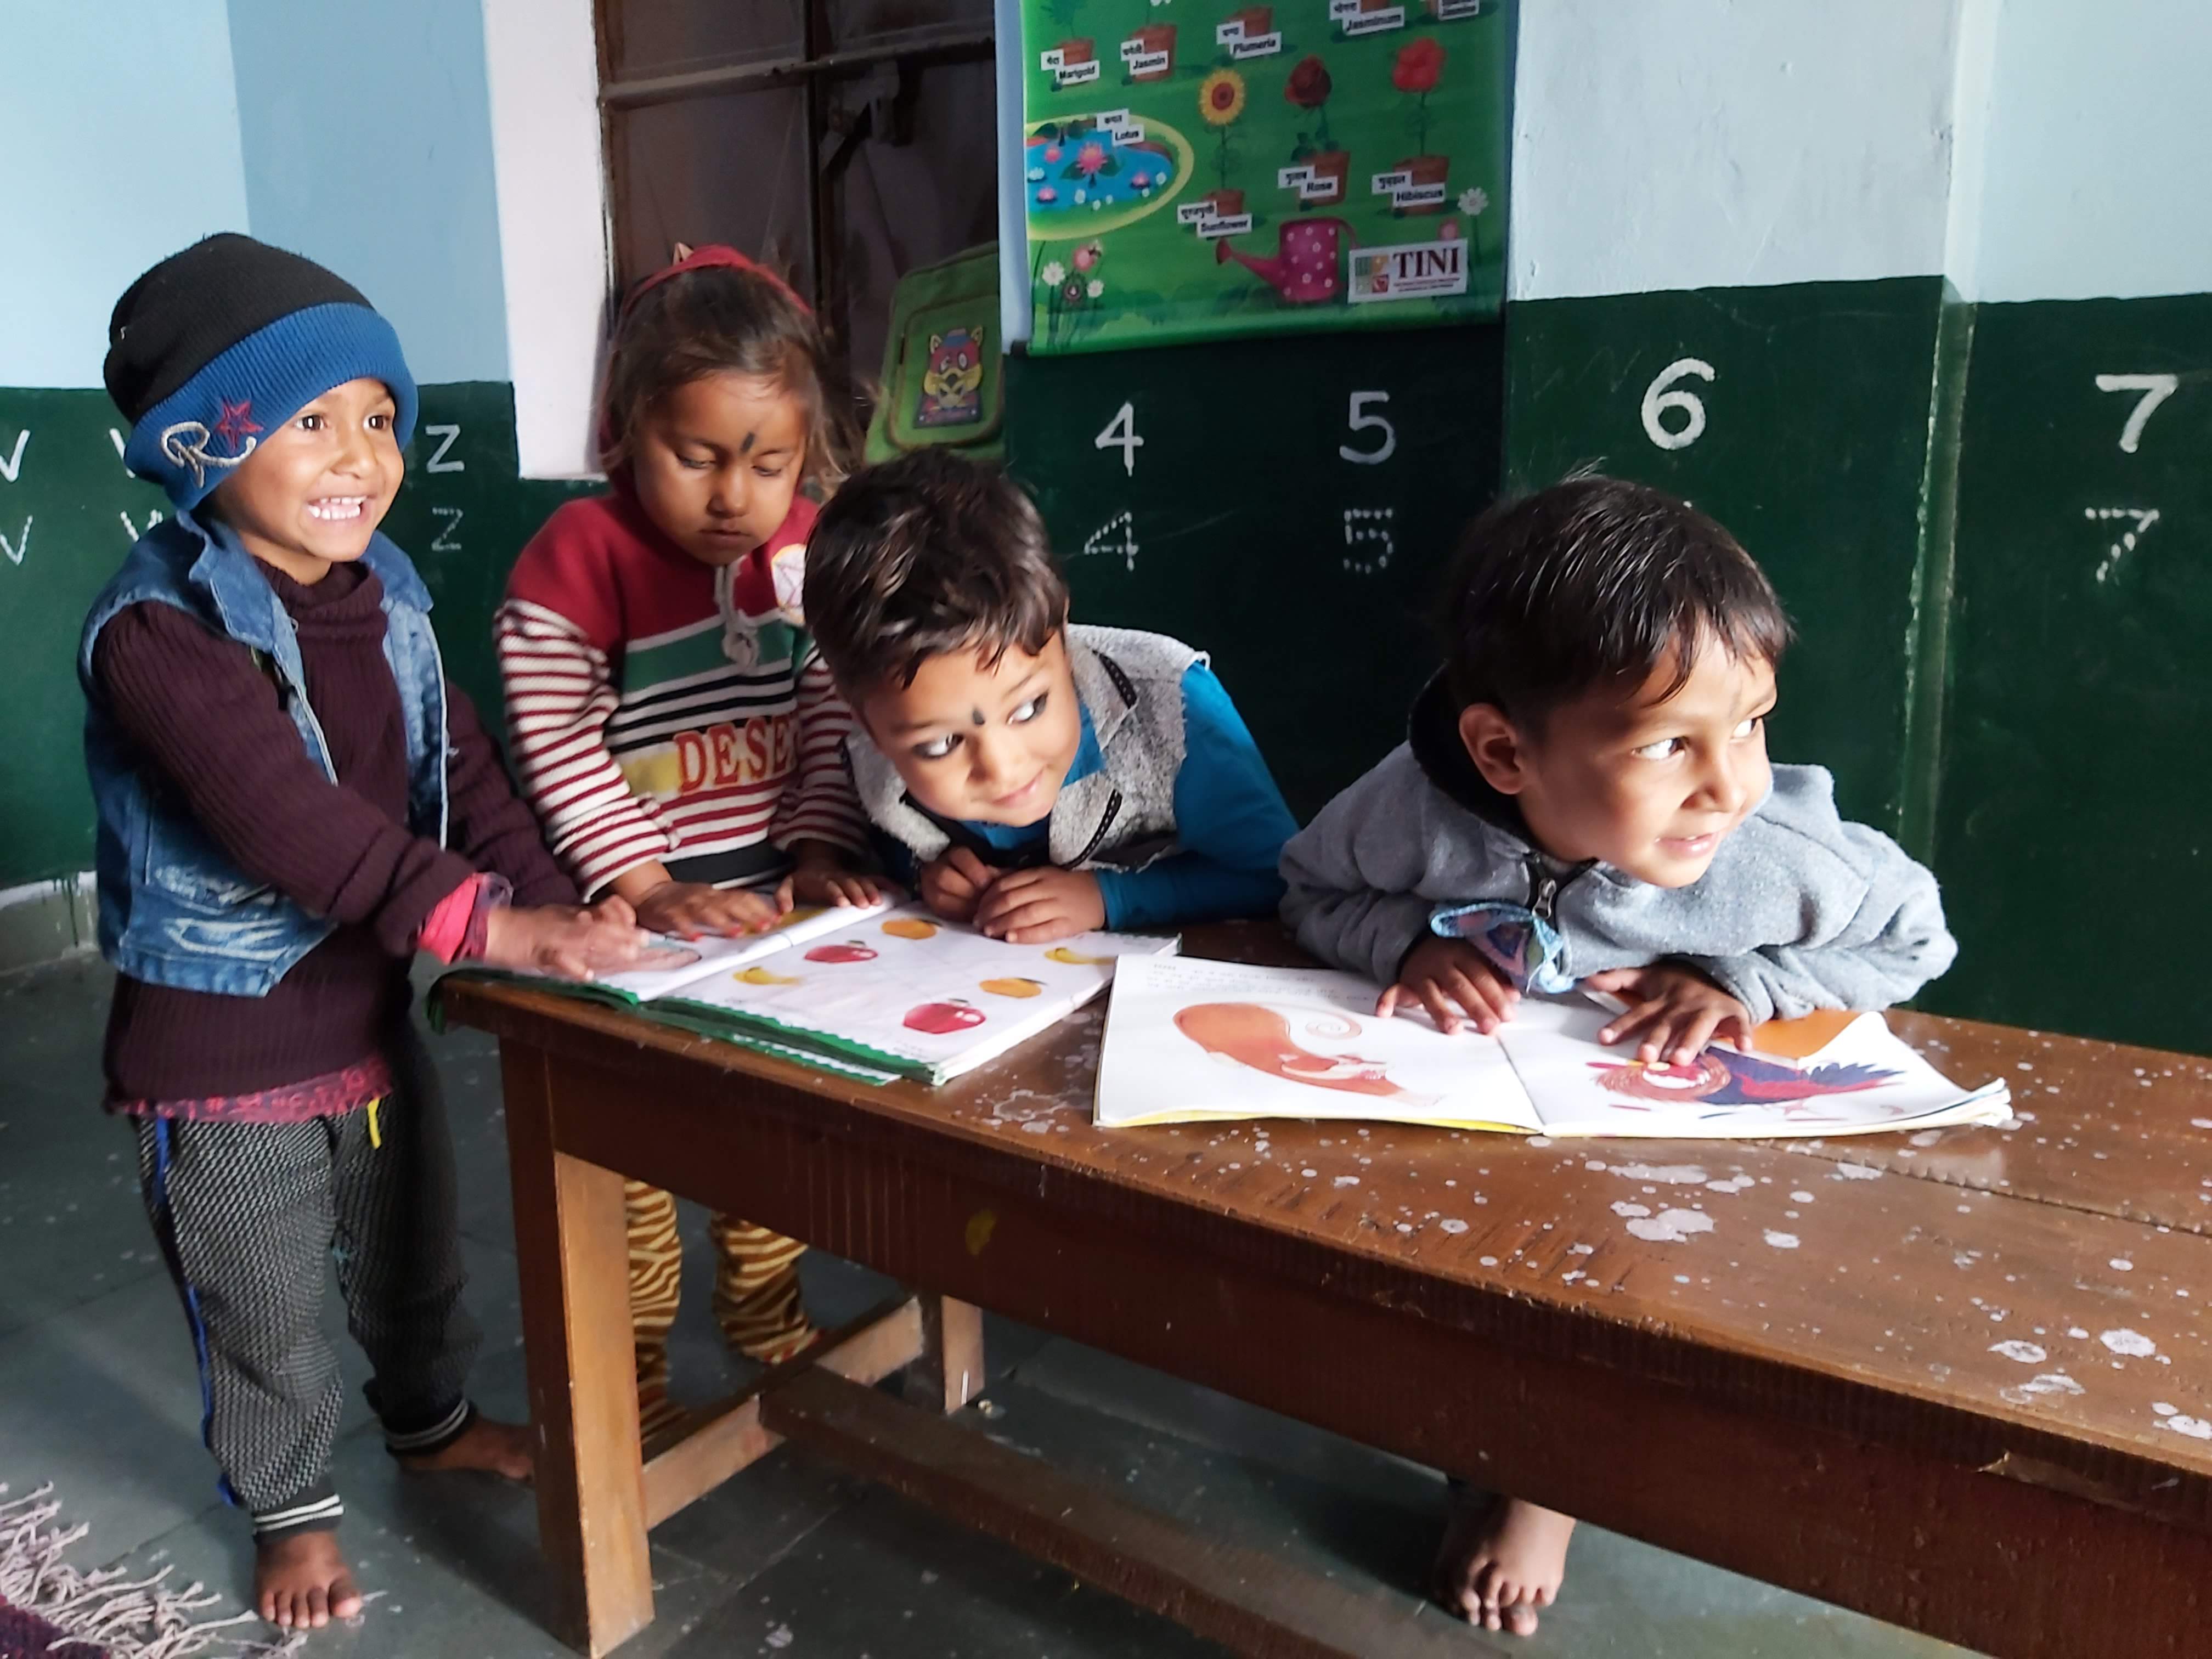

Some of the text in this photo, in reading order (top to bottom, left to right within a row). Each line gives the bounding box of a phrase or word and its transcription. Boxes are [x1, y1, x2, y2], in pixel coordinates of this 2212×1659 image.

[1059, 65, 1096, 79] Marigold
[1115, 131, 1139, 141] Lotus
[1306, 182, 1333, 192] Rose
[1396, 190, 1443, 202] Hibiscus
[1393, 247, 1459, 278] TINI
[1096, 358, 2178, 477] 4 5 6 7
[425, 424, 465, 473] Z
[431, 507, 463, 551] Z
[1084, 508, 2159, 582] 4 5 7
[674, 715, 799, 792] DESE
